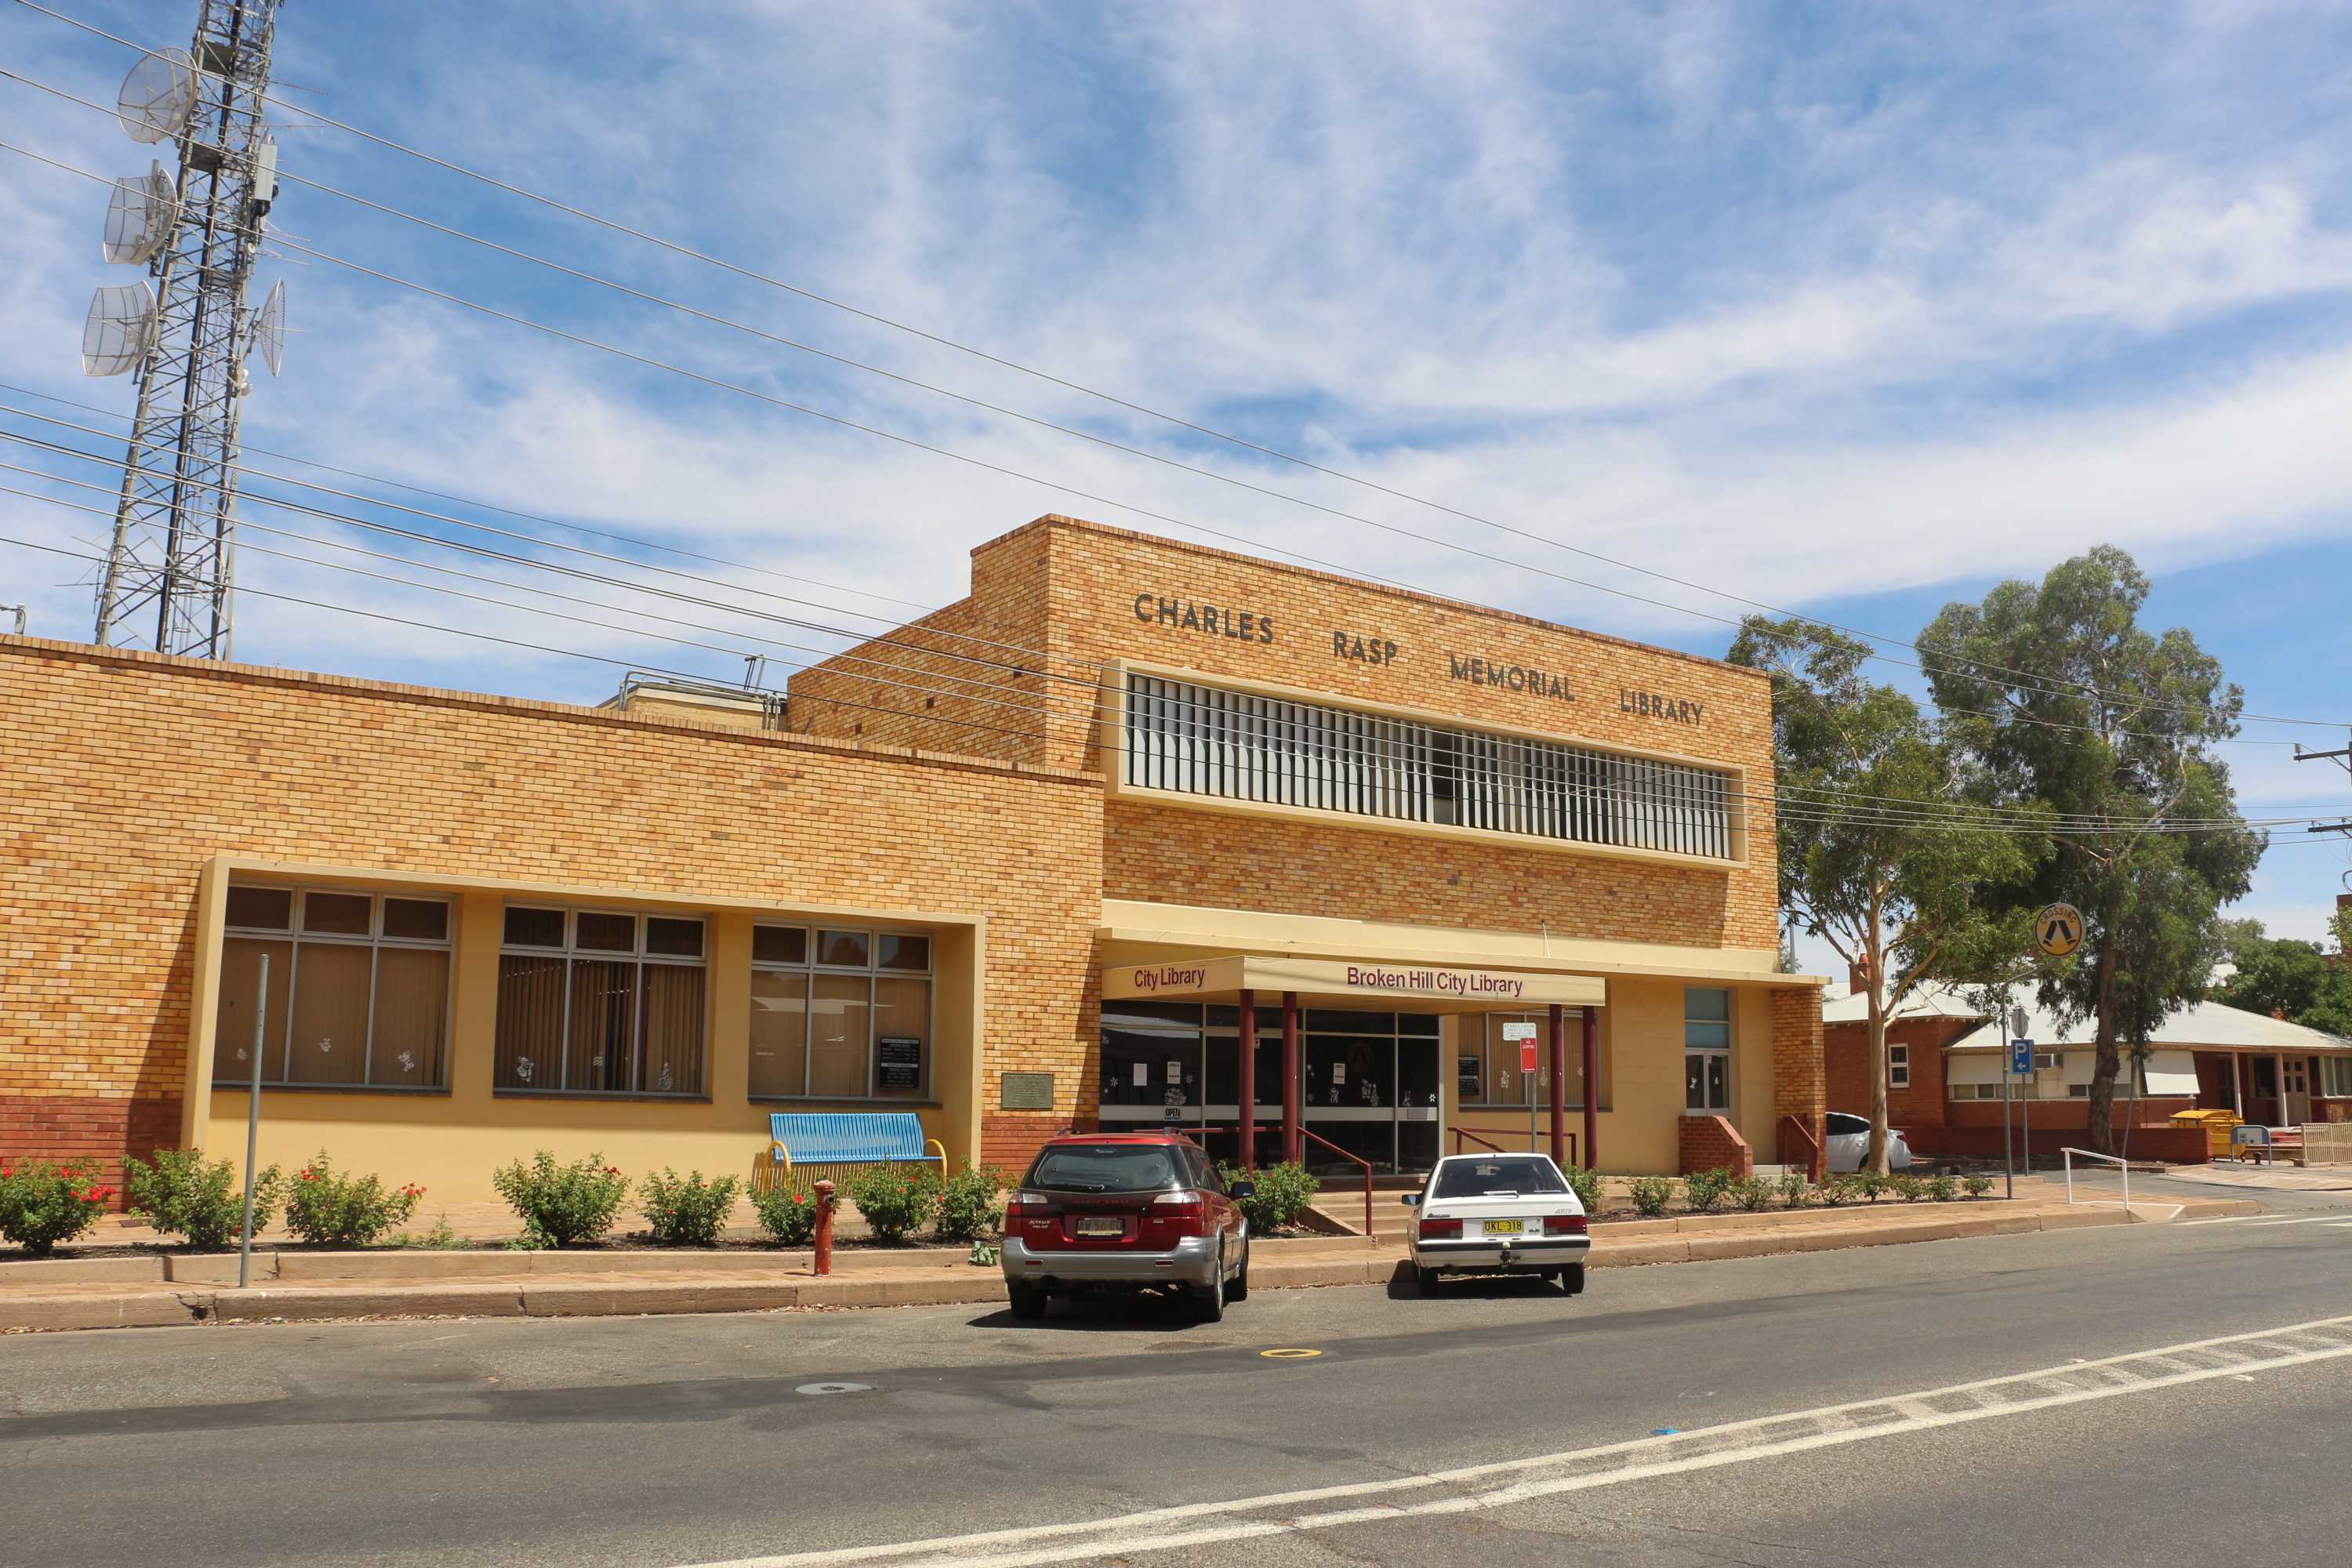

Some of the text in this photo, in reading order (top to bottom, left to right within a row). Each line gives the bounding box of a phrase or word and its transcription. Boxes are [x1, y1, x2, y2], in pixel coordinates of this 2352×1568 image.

[1134, 593, 1704, 726] CHARLES RASP MEMORIAL LIBRARY
[2039, 908, 2077, 924] CROSSING
[1134, 967, 1205, 991] City Library
[1347, 966, 1523, 997] Broken Hill City Library
[2015, 1043, 2027, 1060] P
[1165, 1108, 1181, 1118] OPEN
